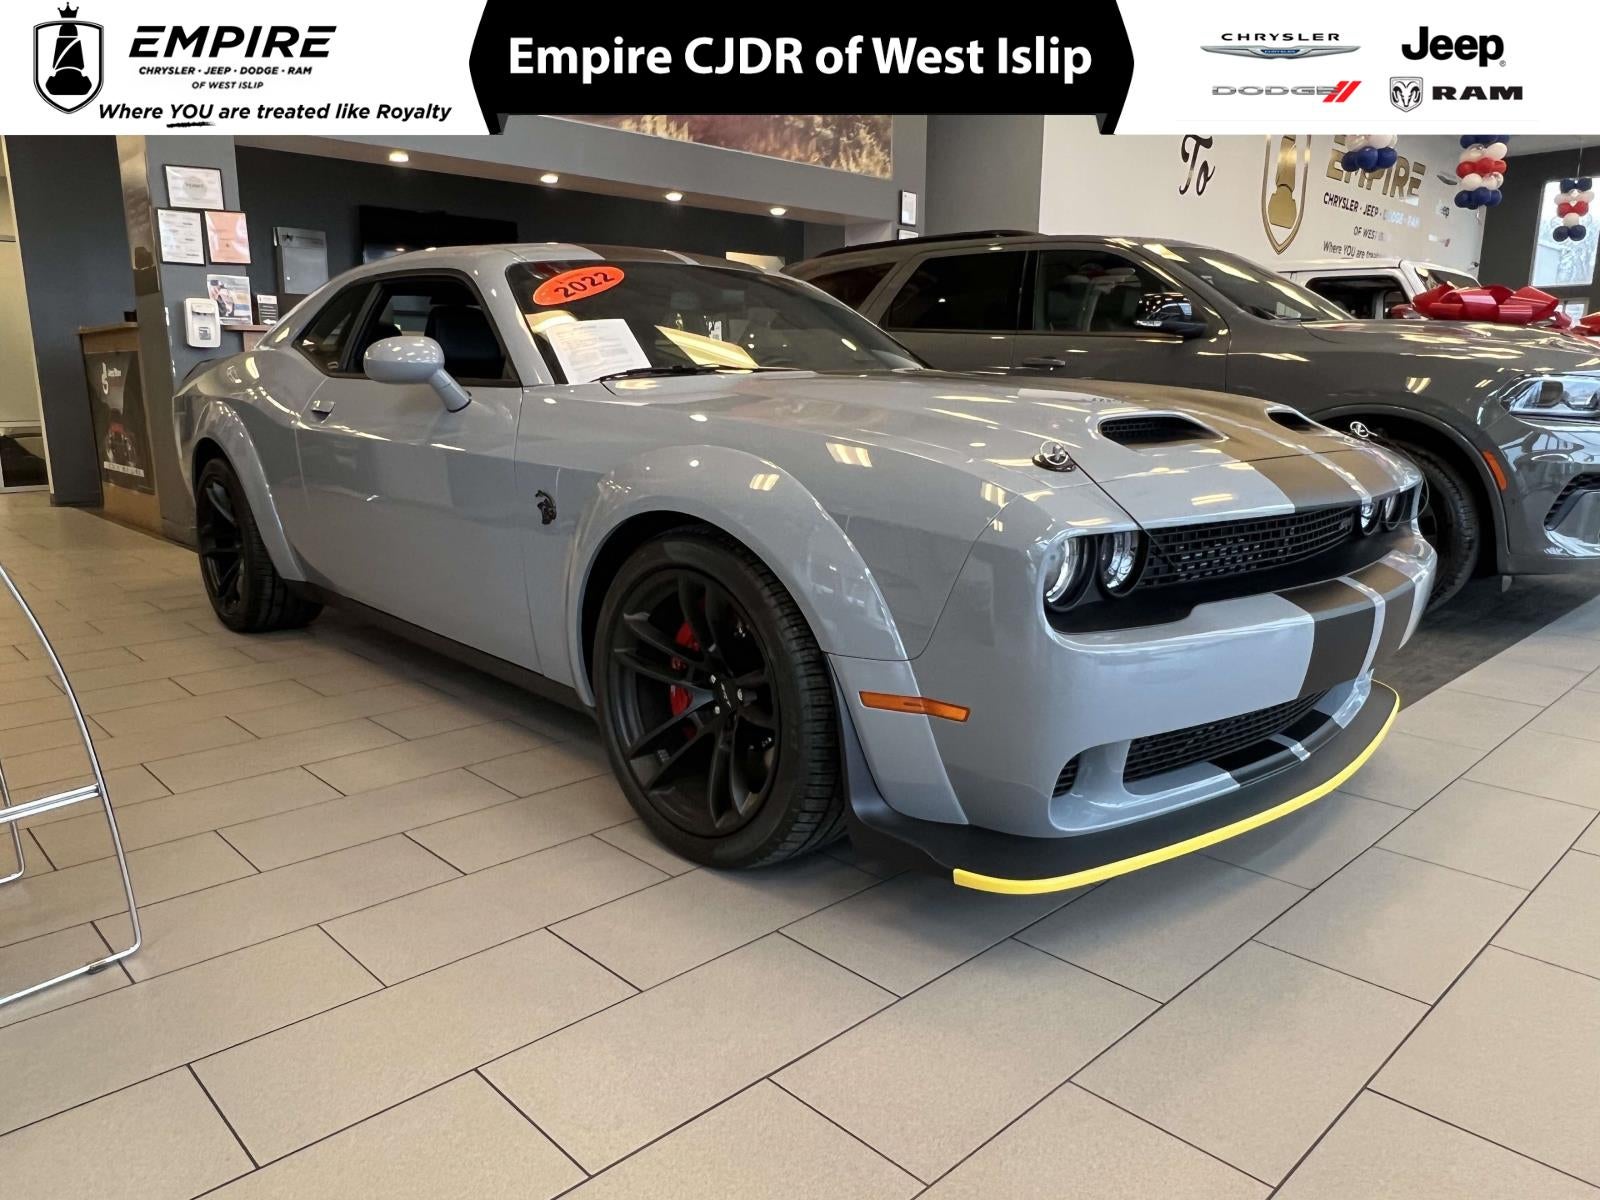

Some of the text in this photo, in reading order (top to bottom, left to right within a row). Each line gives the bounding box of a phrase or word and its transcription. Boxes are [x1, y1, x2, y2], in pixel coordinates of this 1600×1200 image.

[1179, 134, 1216, 196] To
[1323, 191, 1359, 213] CHRYSLER
[1362, 203, 1379, 218] JEEP
[1323, 240, 1343, 255] Where
[1343, 244, 1356, 258] YOU
[553, 271, 616, 299] 2022
